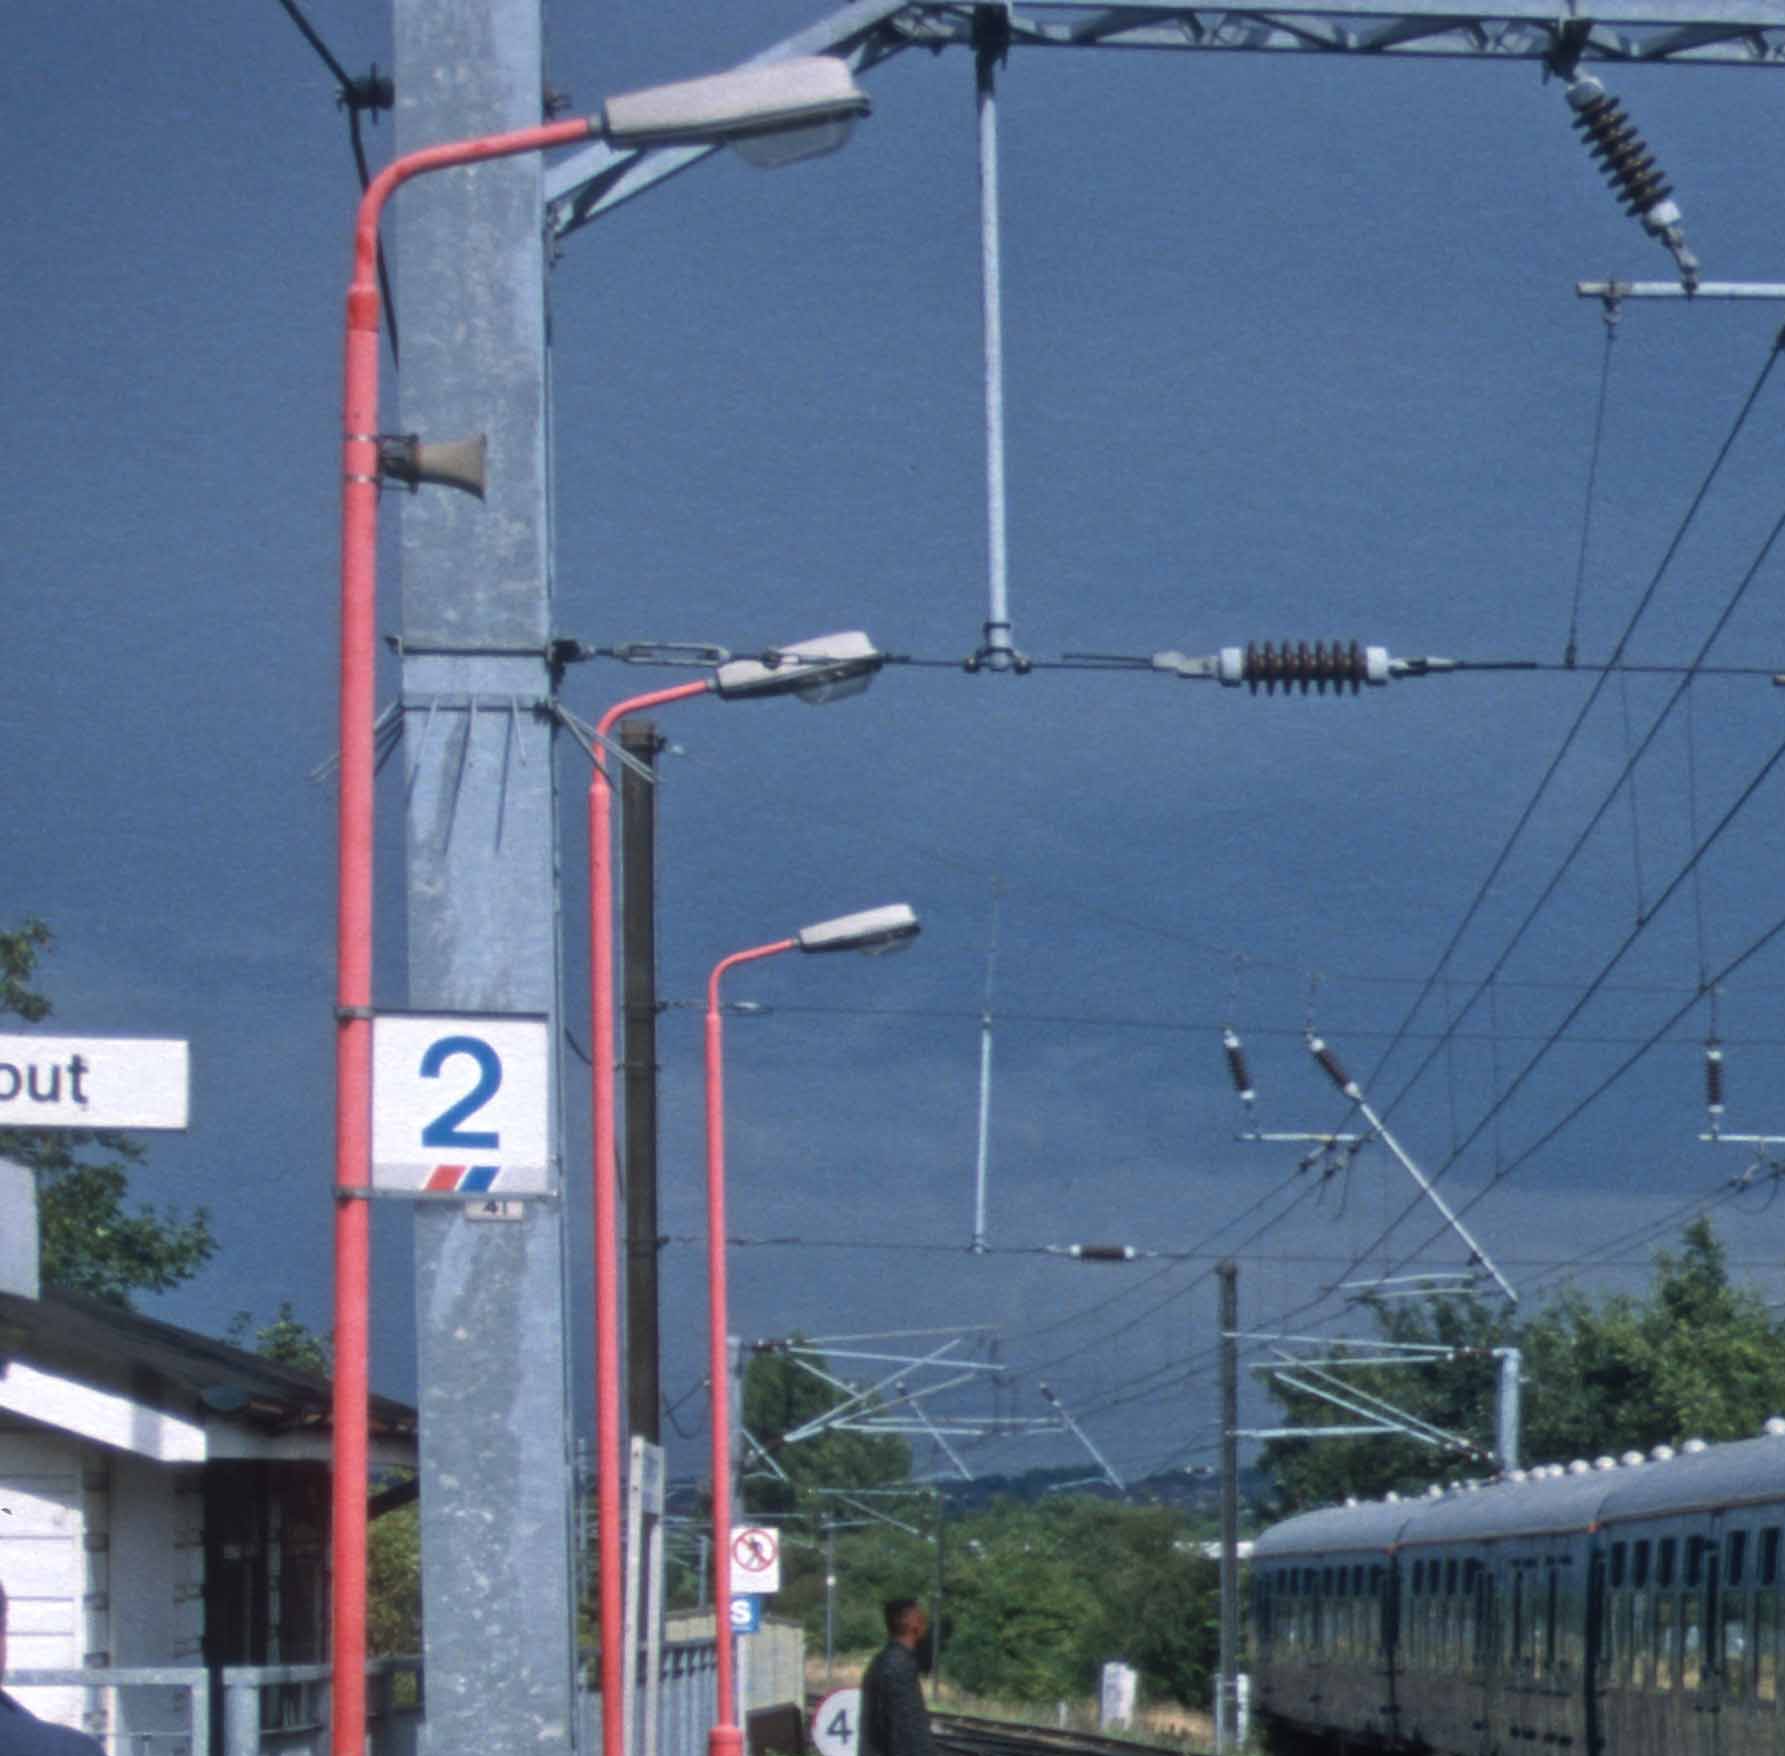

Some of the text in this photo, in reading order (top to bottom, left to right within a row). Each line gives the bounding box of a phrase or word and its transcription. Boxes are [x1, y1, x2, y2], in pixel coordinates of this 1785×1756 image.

[0, 1053, 89, 1104] out
[420, 1035, 502, 1149] 2
[825, 1709, 853, 1745] 4
